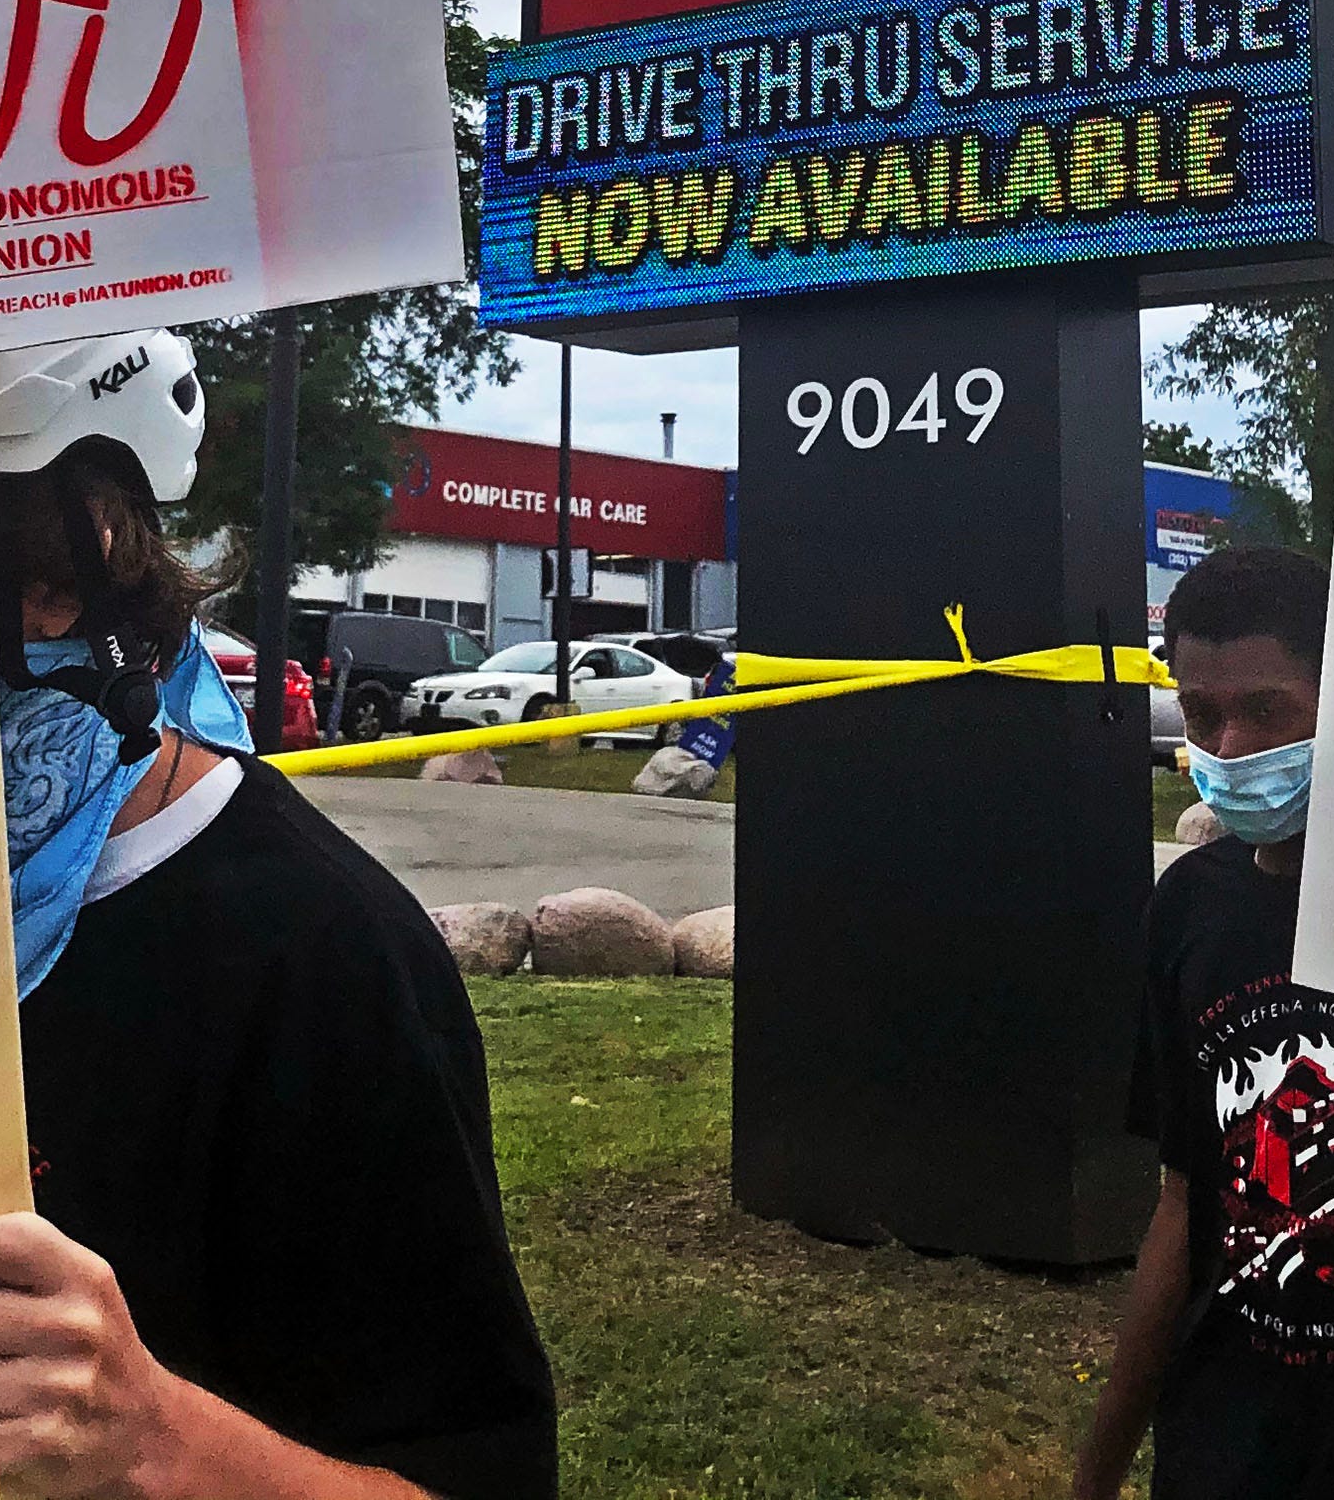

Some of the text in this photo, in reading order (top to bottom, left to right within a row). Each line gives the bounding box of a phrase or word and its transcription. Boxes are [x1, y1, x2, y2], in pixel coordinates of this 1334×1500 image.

[503, 62, 699, 165] DRIVE
[715, 20, 910, 131] THRU
[533, 99, 1239, 276] NOW AVAILABLE
[787, 366, 1007, 457] 9049
[443, 480, 547, 513] COMPLETE
[600, 499, 648, 526] CARE
